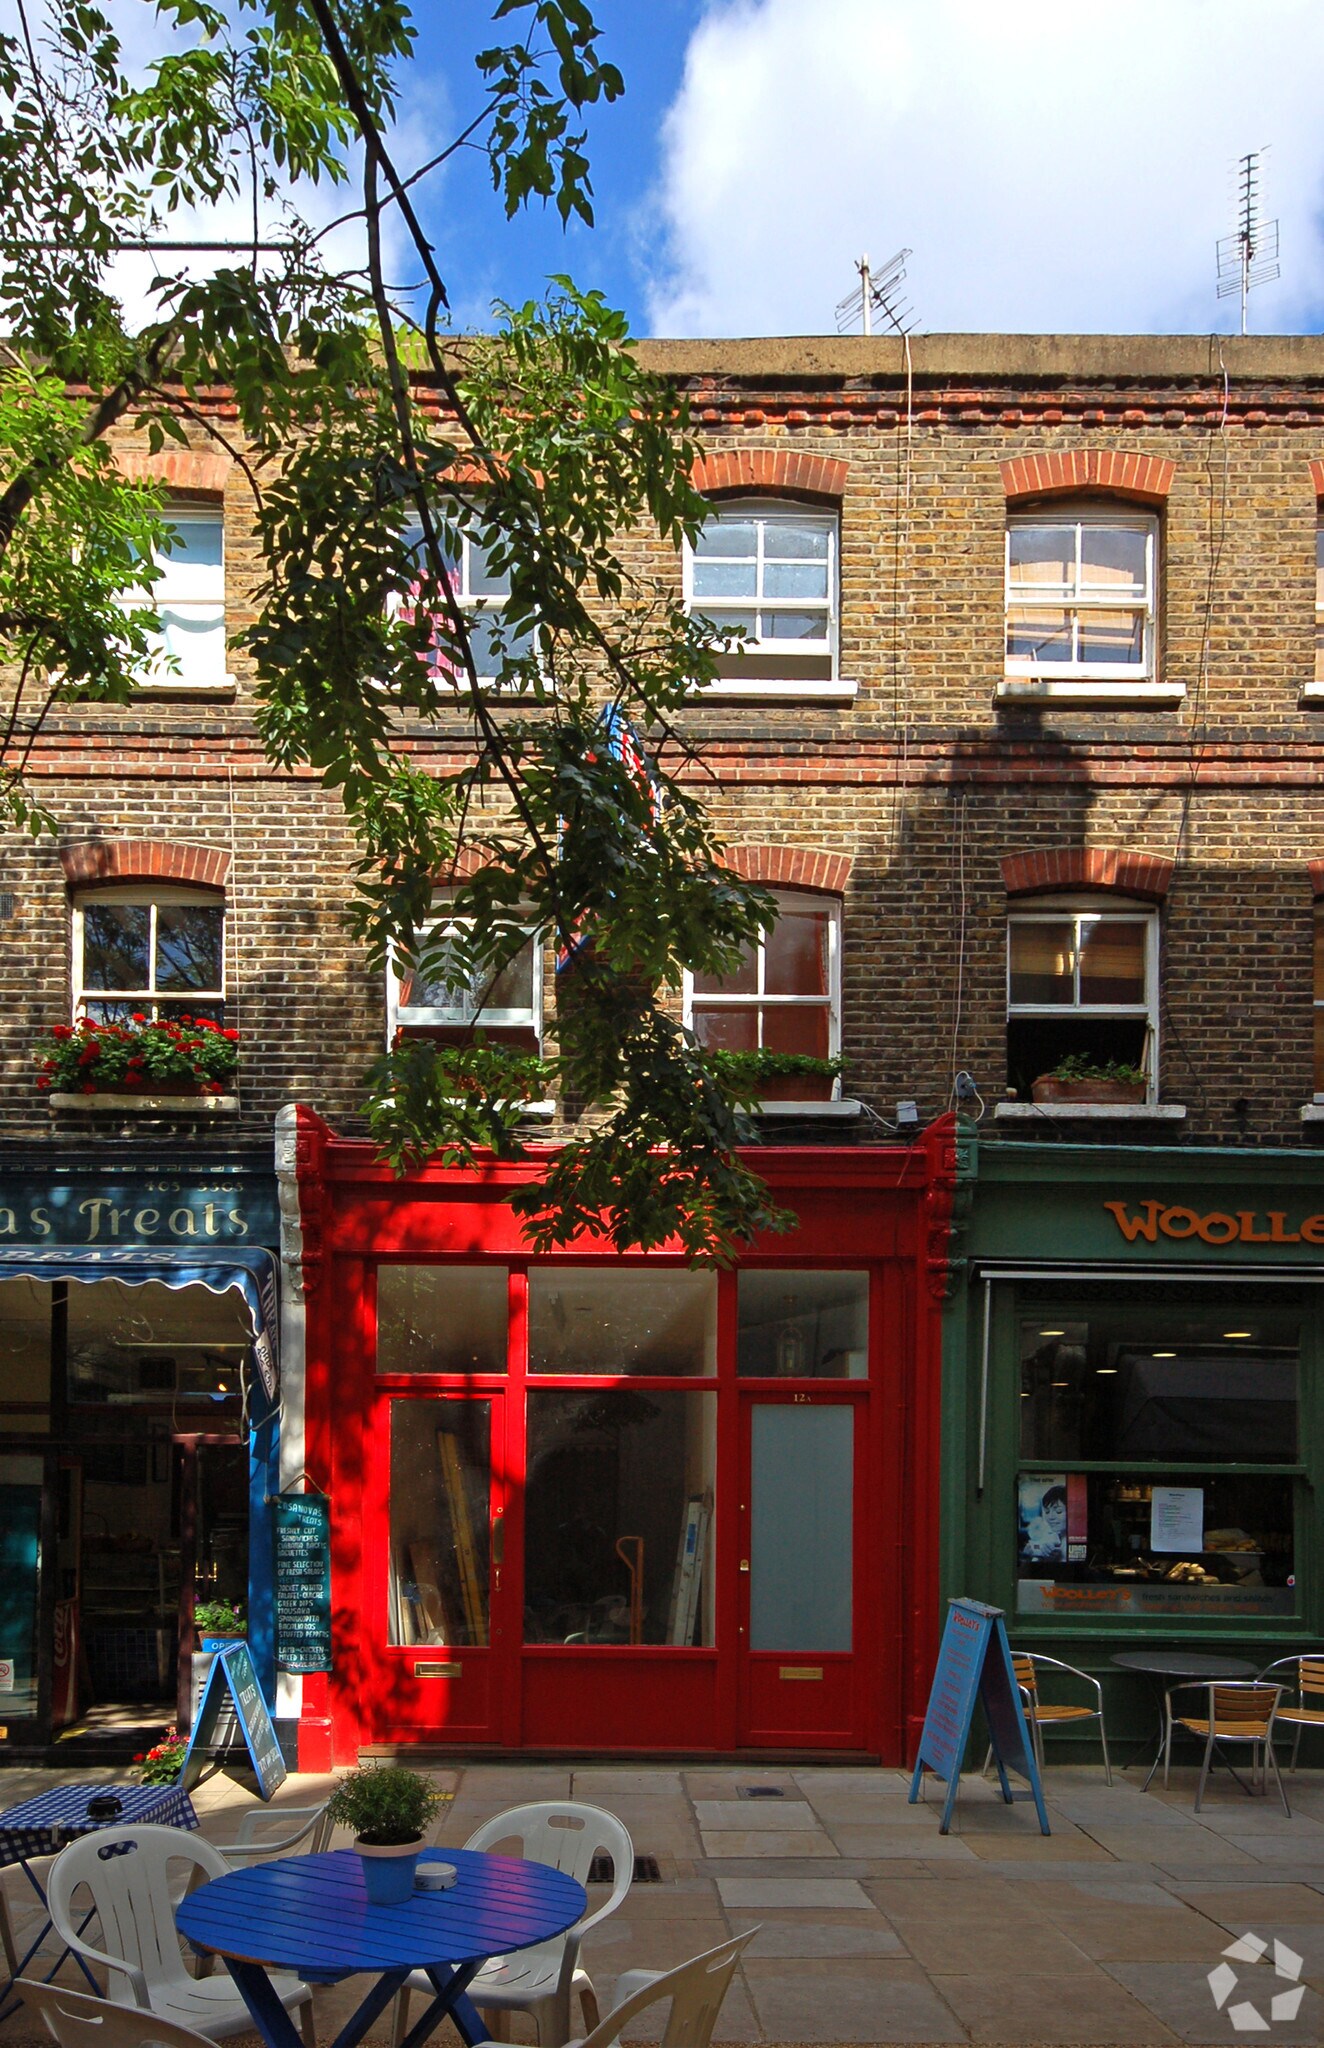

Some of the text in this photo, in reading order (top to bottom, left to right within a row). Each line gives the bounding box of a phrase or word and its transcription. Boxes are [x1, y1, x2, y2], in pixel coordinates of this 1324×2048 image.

[79, 1198, 249, 1242] Treats
[0, 1250, 177, 1265] REATS
[292, 1560, 324, 1568] SELECTION
[1142, 1593, 1166, 1602] fresh
[1167, 1594, 1221, 1602] sandwiches
